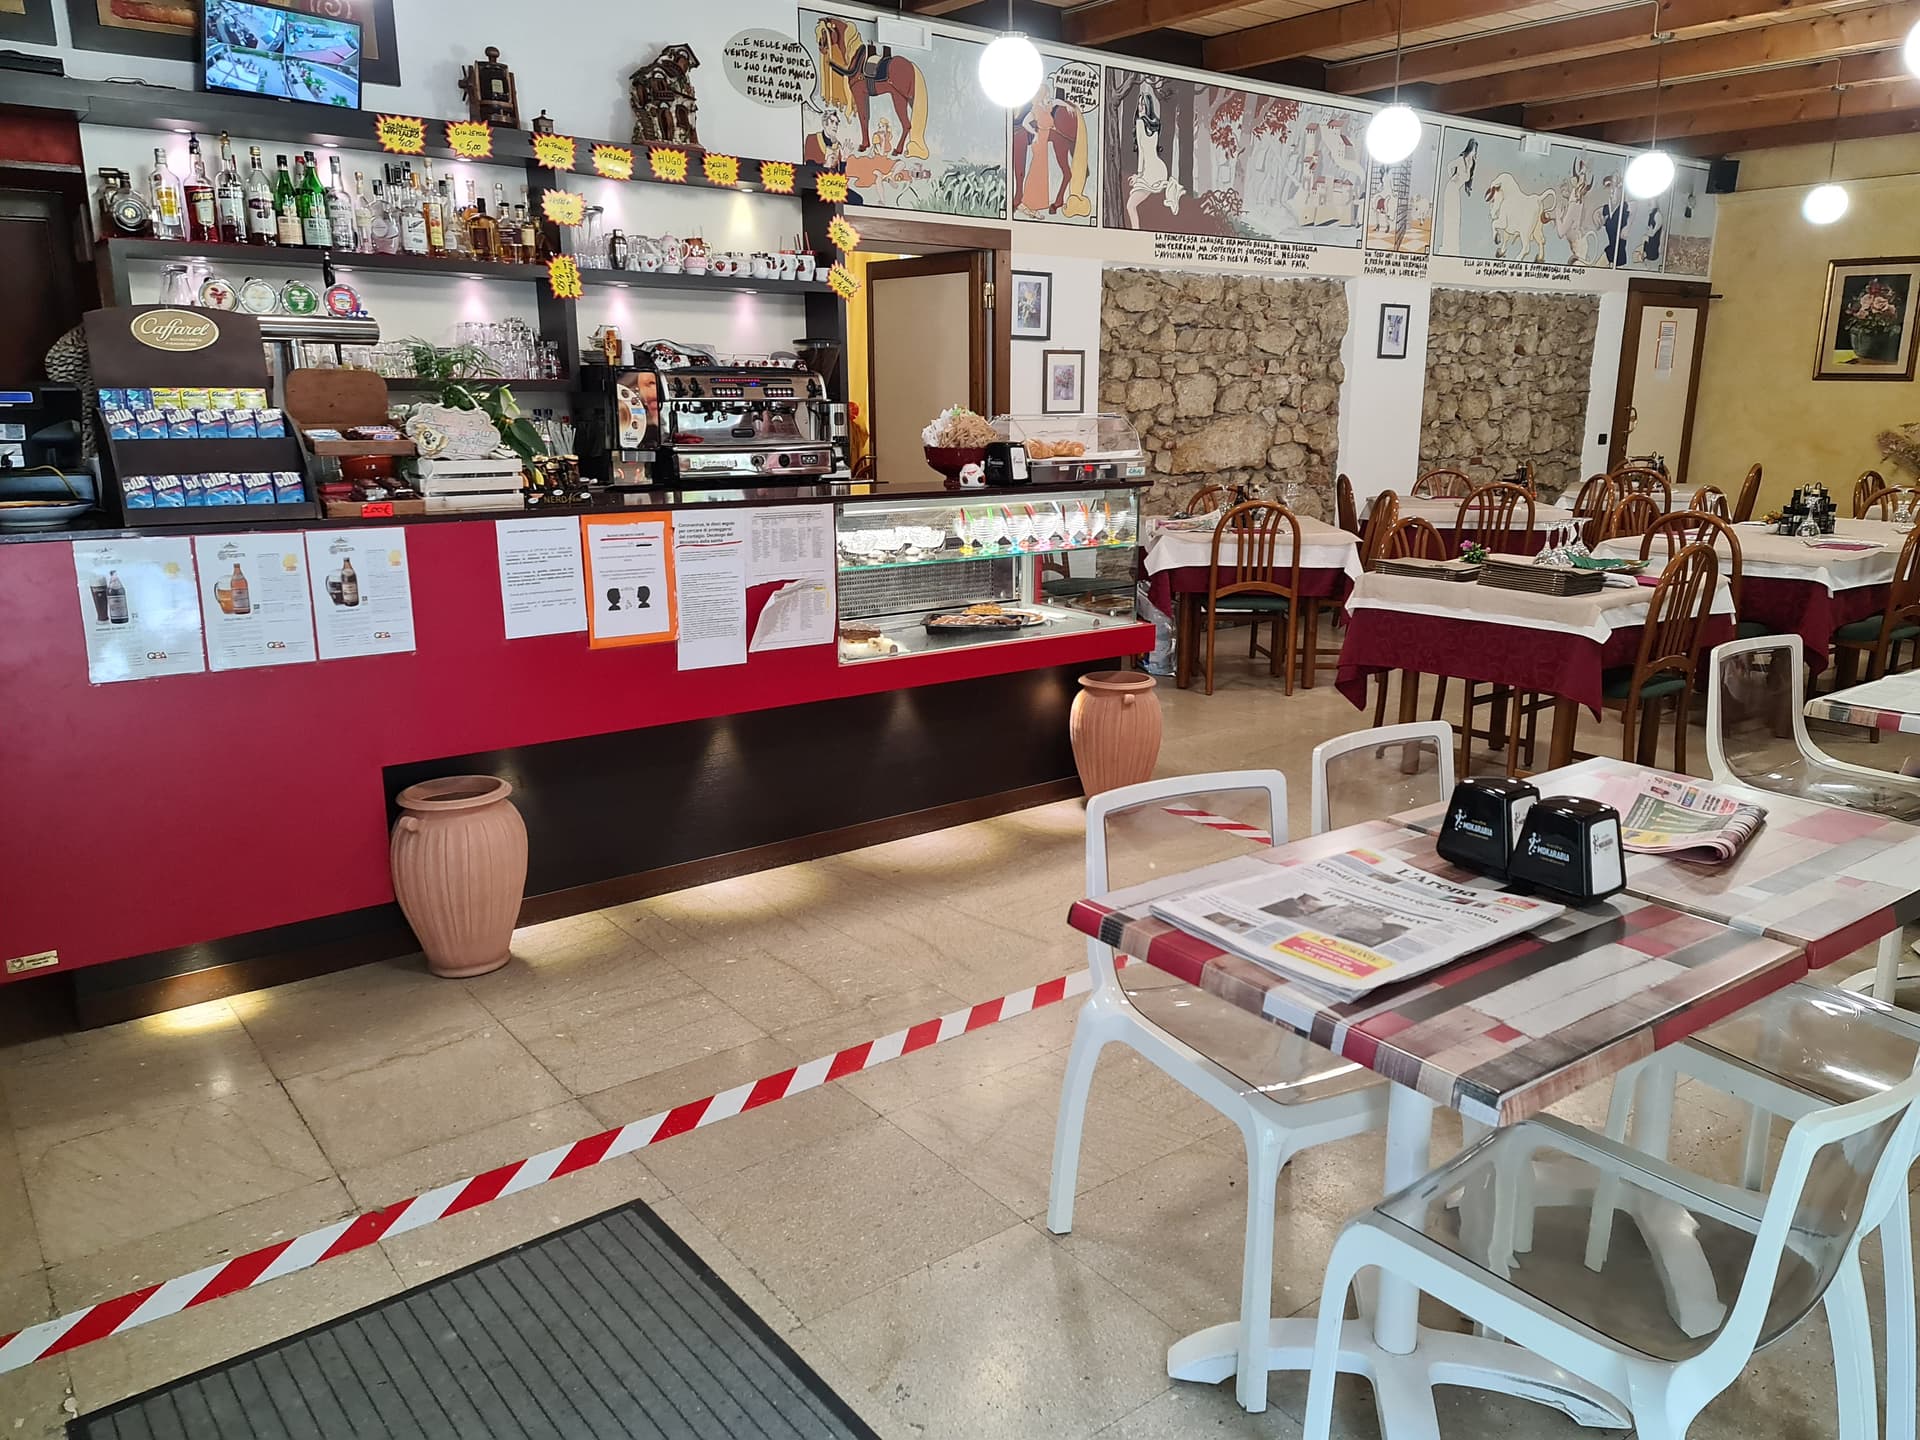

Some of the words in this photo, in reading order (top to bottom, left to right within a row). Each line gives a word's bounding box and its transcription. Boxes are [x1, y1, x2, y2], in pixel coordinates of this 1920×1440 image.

[753, 40, 780, 50] NELLE
[782, 43, 802, 54] NOTTI
[724, 48, 758, 60] VENTOSE
[787, 59, 811, 68] UDIRE
[734, 61, 742, 69] IL
[744, 62, 760, 72] SUO
[763, 65, 787, 75] CANTO
[747, 75, 774, 87] NELLA
[779, 80, 802, 90] GOLA
[1089, 72, 1097, 80] LA
[747, 86, 773, 99] DELLA
[775, 91, 804, 102] CHIUSA
[658, 154, 682, 166] HUGO
[1253, 256, 1272, 265] FOSSE
[1281, 251, 1310, 260] NESSUNO
[141, 317, 210, 342] Caffarel
[1396, 868, 1478, 897] L'Arena
